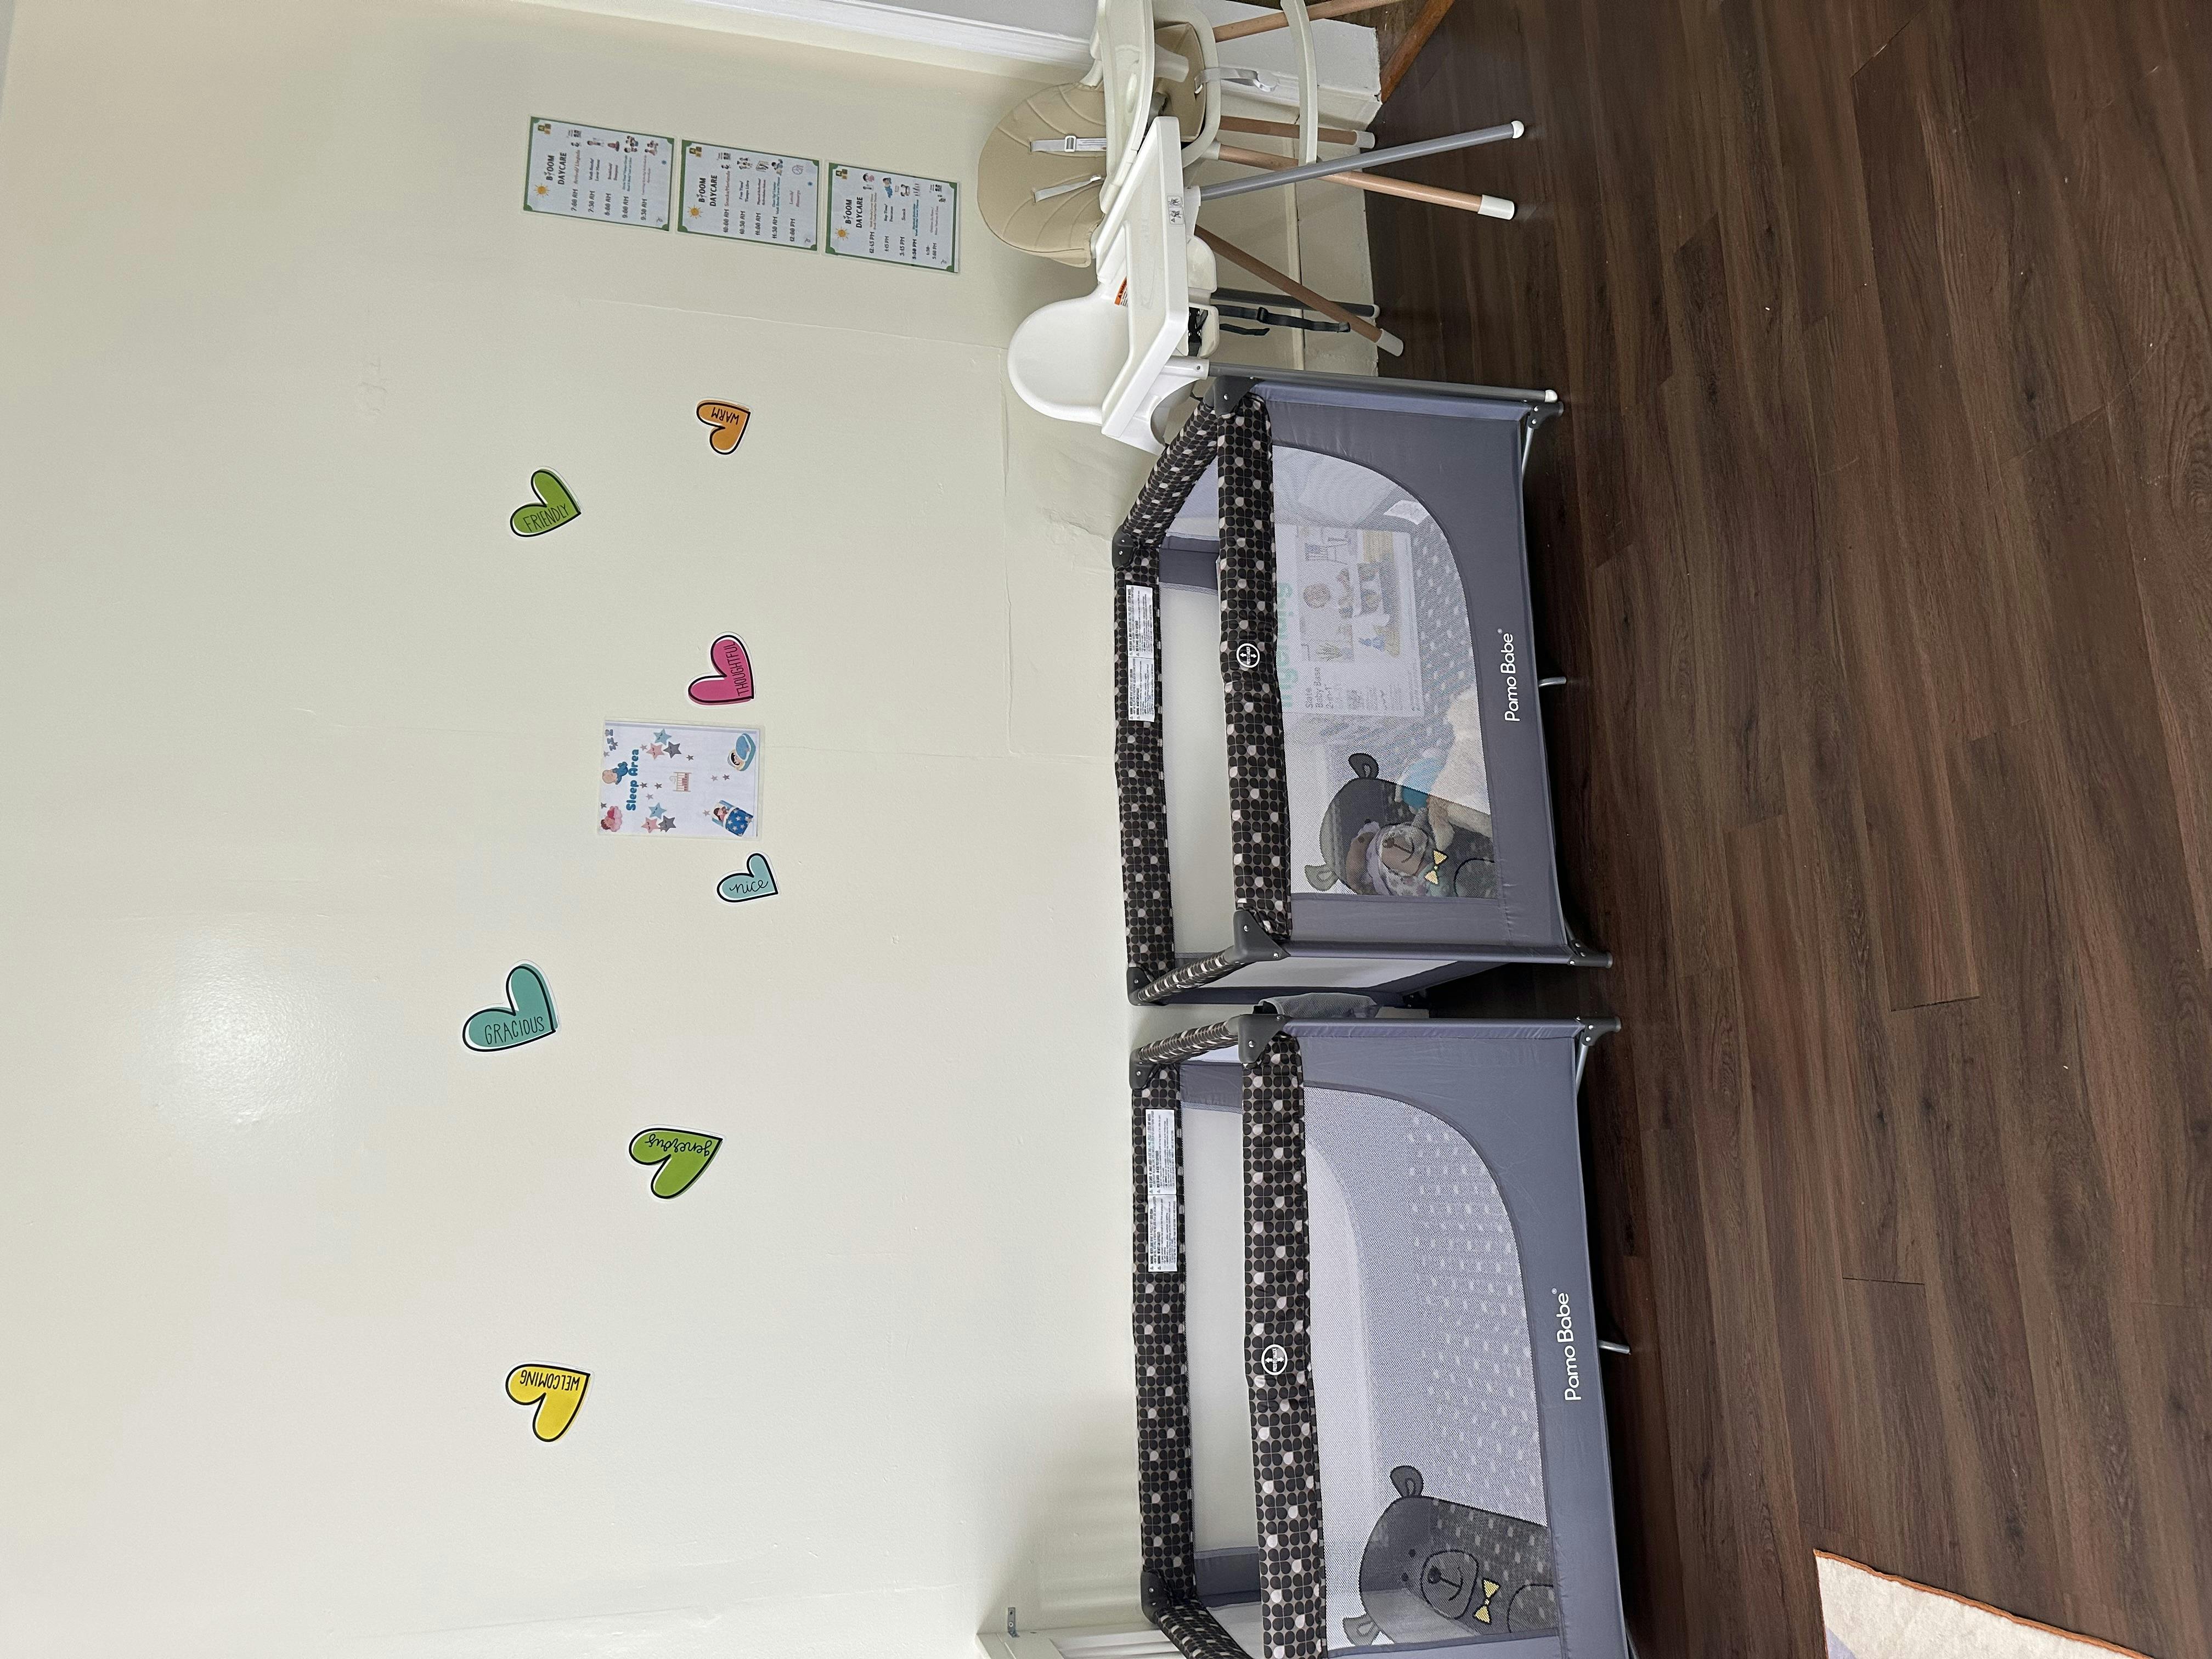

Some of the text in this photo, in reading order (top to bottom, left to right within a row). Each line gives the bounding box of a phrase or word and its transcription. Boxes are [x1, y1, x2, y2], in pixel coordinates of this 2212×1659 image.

[557, 153, 566, 184] DAYCARE
[572, 189, 578, 198] AM
[589, 190, 595, 200] AM
[606, 193, 611, 202] AM
[623, 196, 629, 205] AM
[642, 198, 647, 207] AM
[724, 209, 729, 218] AM
[740, 211, 745, 219] AM
[755, 213, 761, 222] AM
[772, 216, 778, 225] AM
[790, 218, 795, 227] PM
[869, 232, 874, 240] PM
[900, 236, 905, 245] PM
[912, 239, 917, 247] PM
[711, 407, 740, 425] WARM
[523, 504, 569, 532] FRIENDLY
[723, 642, 749, 696] THOUGHTFUL
[1504, 676, 1521, 721] Pamo
[626, 749, 639, 811] Sleep Area
[729, 880, 768, 894] nice
[485, 1016, 544, 1045] GRACIOUS
[644, 1133, 712, 1157] generous
[1564, 1345, 1582, 1401] Pamo
[520, 1369, 580, 1391] WELCOMING
